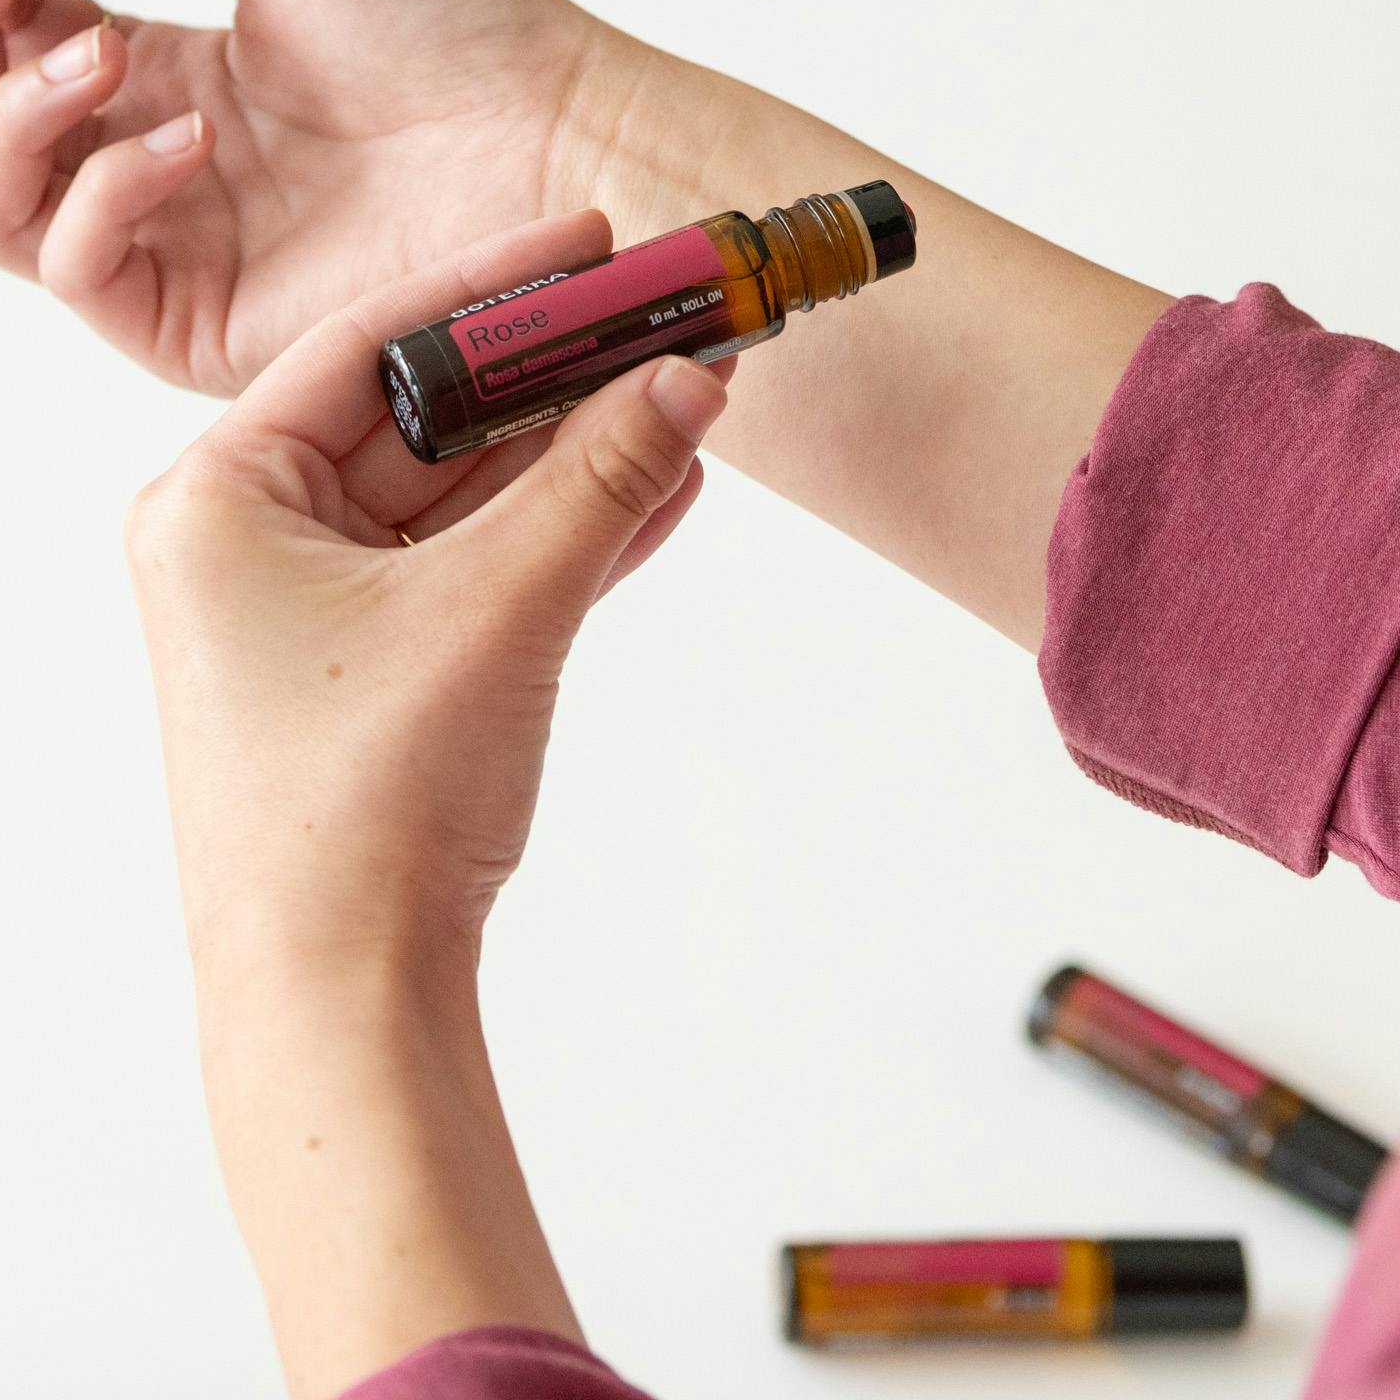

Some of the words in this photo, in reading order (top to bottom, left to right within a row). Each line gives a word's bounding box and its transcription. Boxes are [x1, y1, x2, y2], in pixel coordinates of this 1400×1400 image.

[649, 312, 663, 326] 10
[663, 306, 680, 321] mL
[681, 296, 708, 313] ROLL
[707, 288, 724, 303] ON
[466, 309, 549, 352] Rose
[485, 366, 520, 388] Rosa
[521, 336, 598, 374] damascena
[486, 407, 559, 440] INGREDIENTS:
